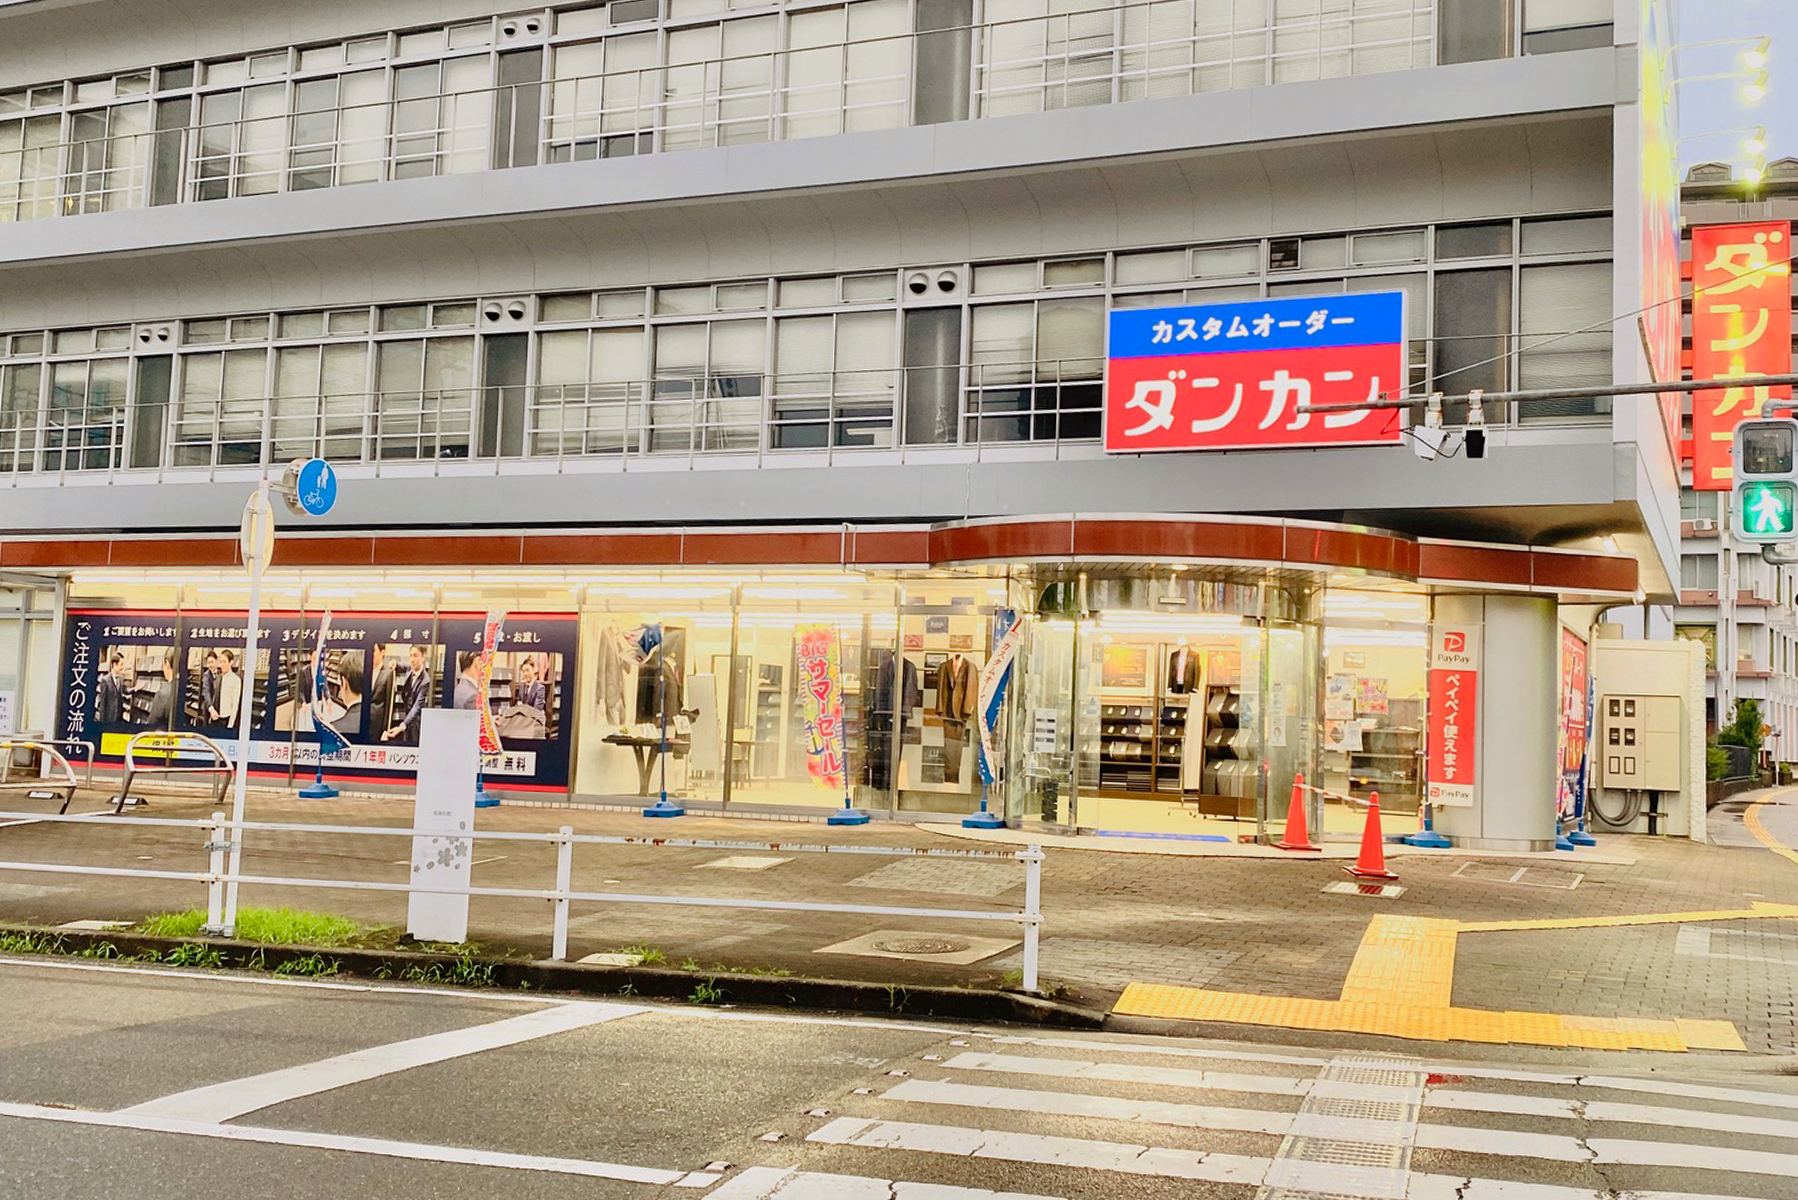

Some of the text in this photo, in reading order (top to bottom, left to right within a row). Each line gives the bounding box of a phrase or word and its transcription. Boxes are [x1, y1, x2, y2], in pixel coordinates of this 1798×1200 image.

[1151, 309, 1355, 344] カスタムオーダー
[1123, 369, 1380, 437] ダンカン
[801, 642, 828, 658] BIG
[1437, 653, 1471, 664] PayPay
[65, 621, 92, 755] ご注文の流れ
[807, 658, 842, 774] サマーセール
[1443, 673, 1461, 780] ペイペイ使えます
[1441, 788, 1470, 799] PayPay
